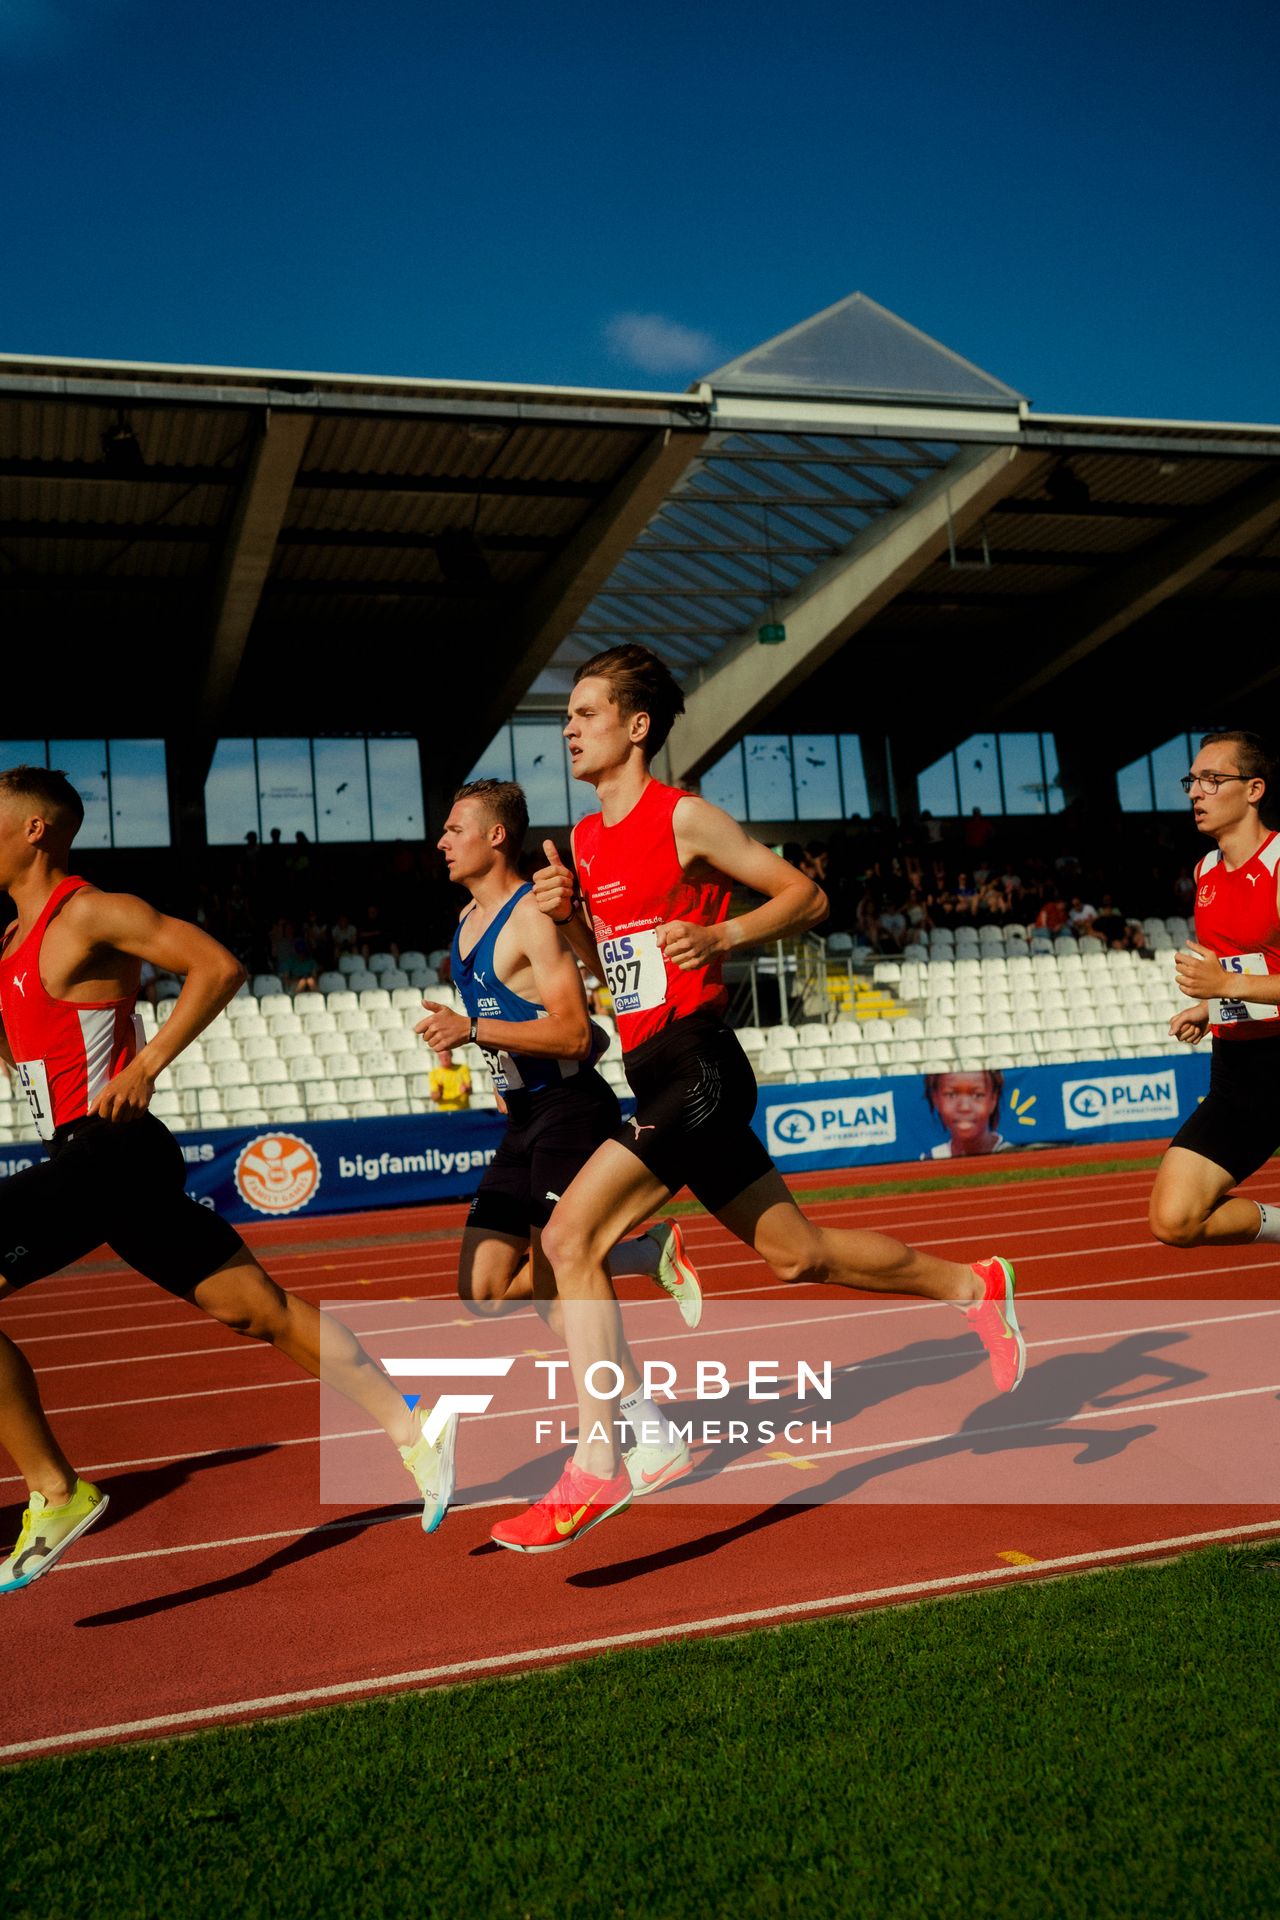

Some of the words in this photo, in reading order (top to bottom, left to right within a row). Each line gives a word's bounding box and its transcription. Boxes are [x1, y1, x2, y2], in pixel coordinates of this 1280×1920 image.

[603, 937, 634, 964] GLS
[606, 960, 641, 995] 597
[1112, 1083, 1171, 1104] PLAN
[821, 1105, 888, 1129] PLAN
[1113, 1106, 1172, 1115] INTERNATIONAL
[823, 1131, 889, 1141] INTERNATIONAL
